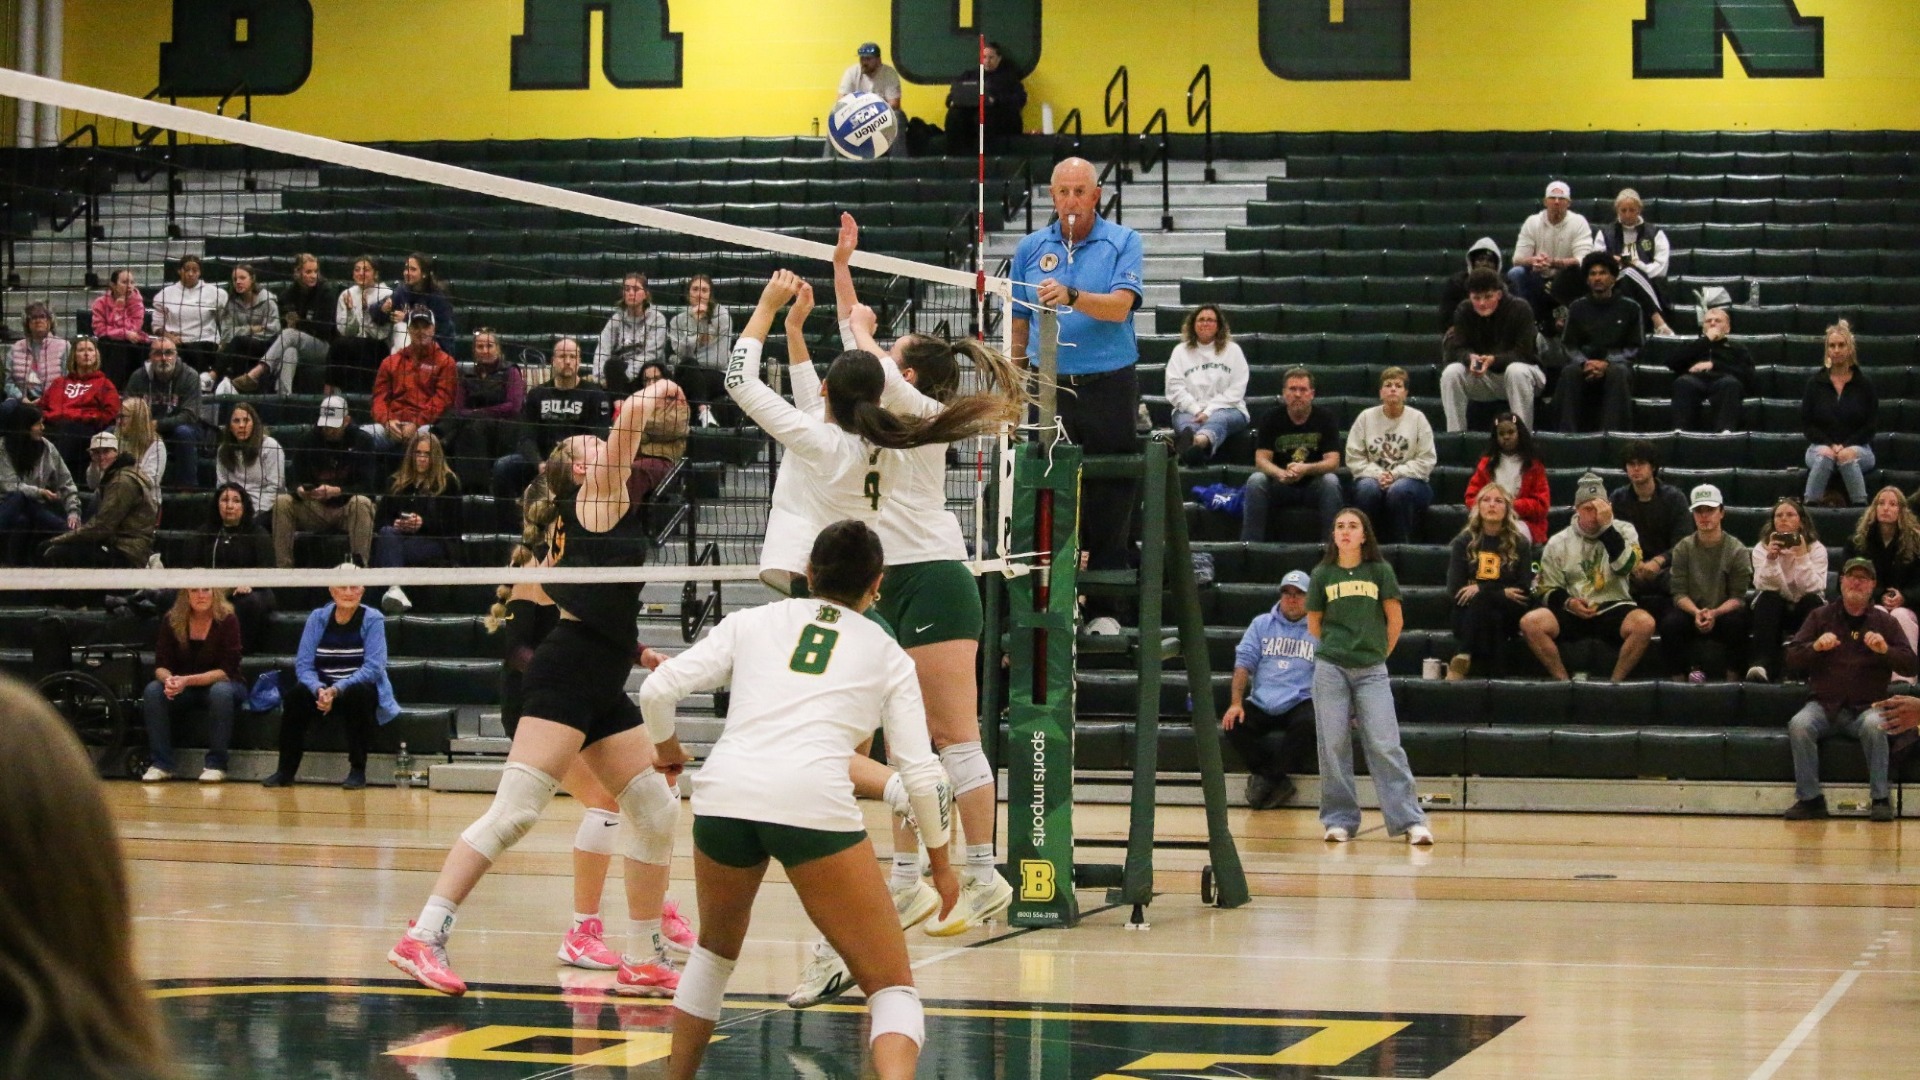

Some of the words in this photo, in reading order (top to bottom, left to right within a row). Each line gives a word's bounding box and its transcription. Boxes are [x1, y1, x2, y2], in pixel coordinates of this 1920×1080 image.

[855, 114, 888, 138] molten
[541, 399, 583, 415] BILLS
[1475, 551, 1501, 580] B
[788, 622, 839, 676] 8
[1261, 637, 1314, 662] CAROLINA
[1030, 731, 1046, 782] sports
[1030, 783, 1047, 847] imports
[1020, 859, 1056, 902] B
